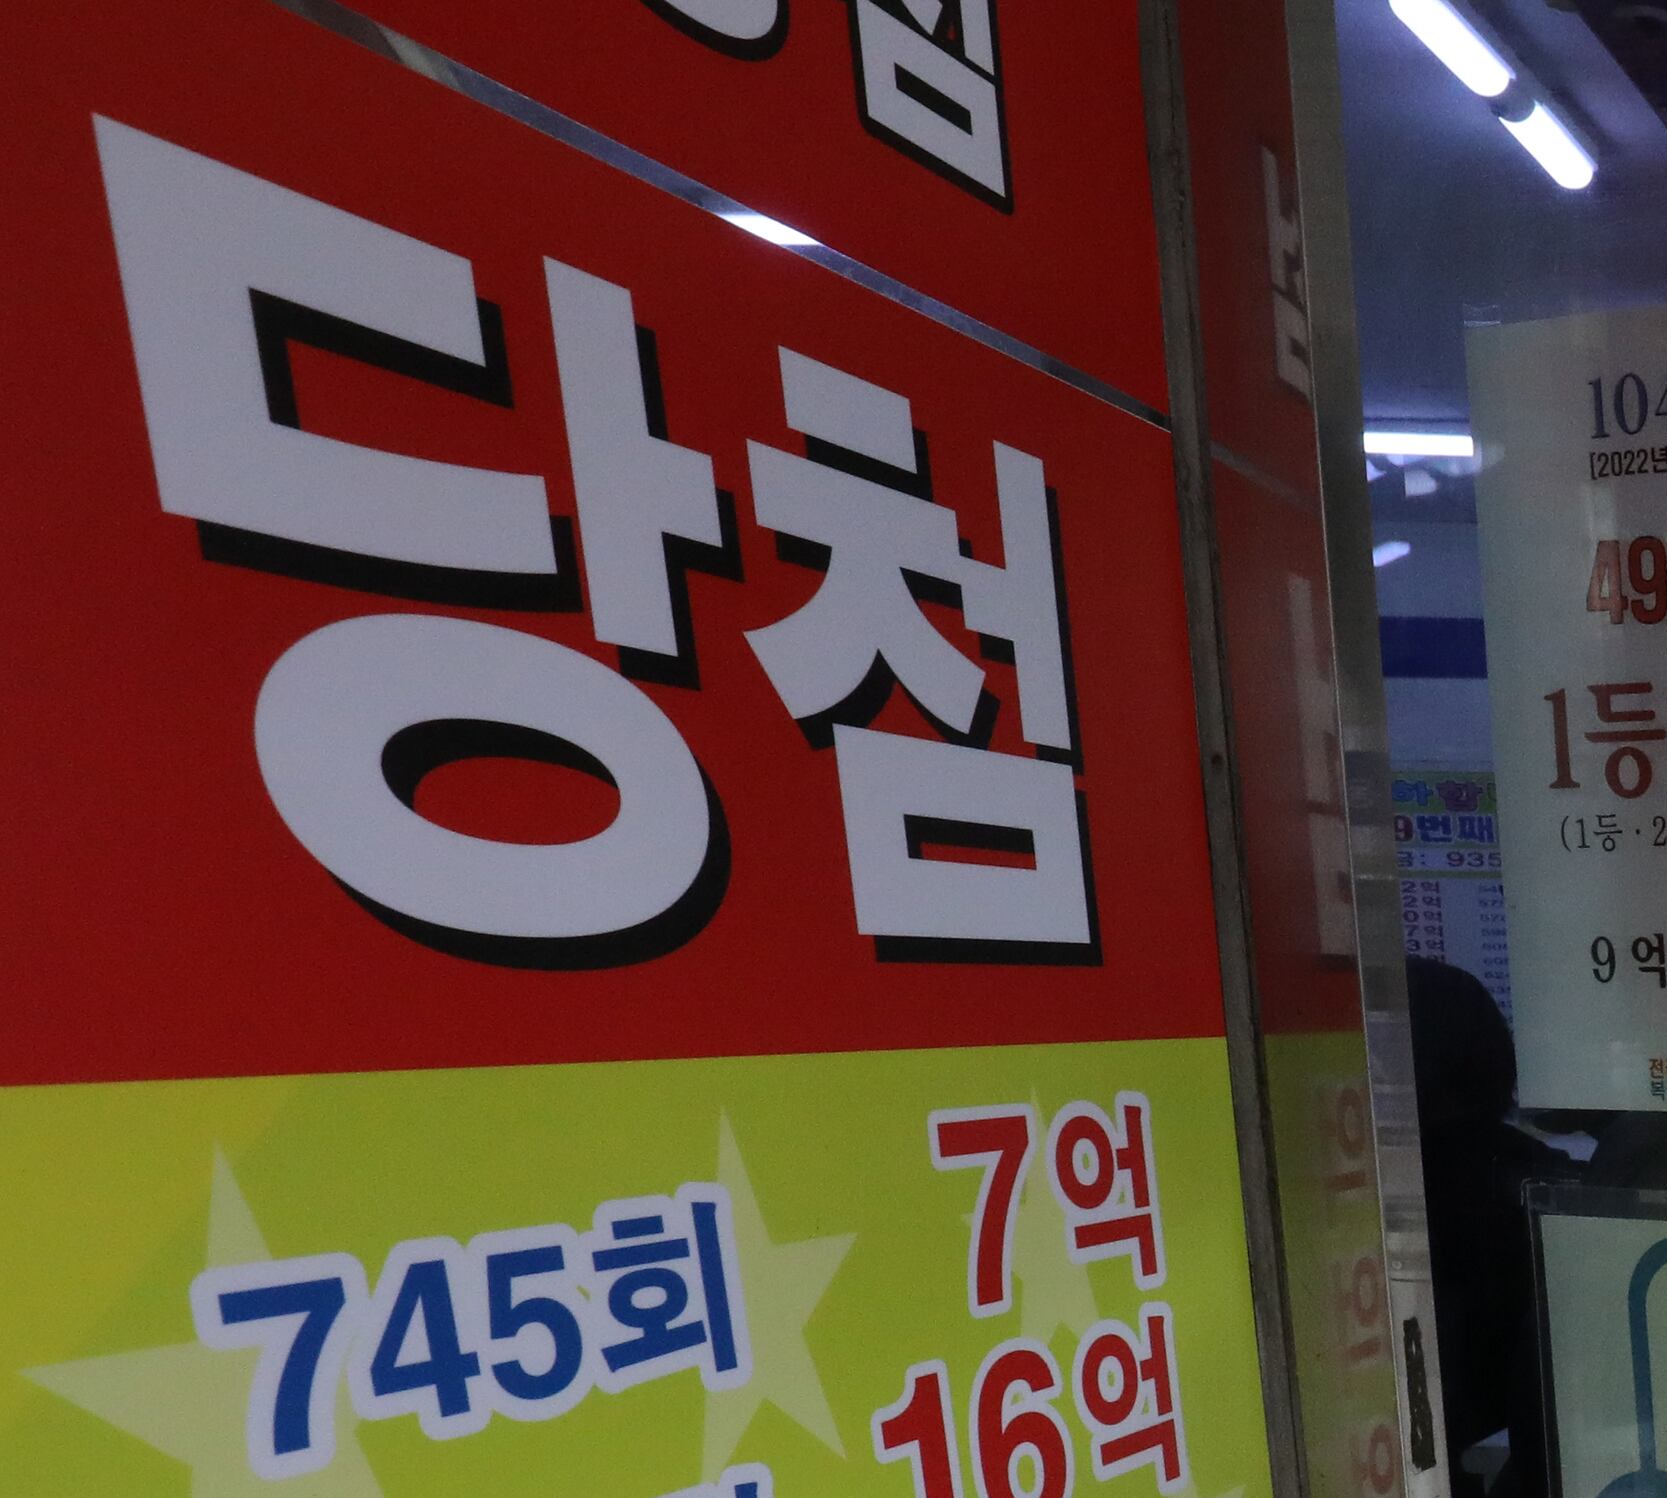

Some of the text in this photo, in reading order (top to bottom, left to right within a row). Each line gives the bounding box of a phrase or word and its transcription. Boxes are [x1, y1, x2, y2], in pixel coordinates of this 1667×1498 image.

[93, 112, 1100, 966] 당첨
[1544, 681, 1667, 800] 1등
[1590, 935, 1617, 984] 9
[218, 1104, 1158, 1457] 745회 7억
